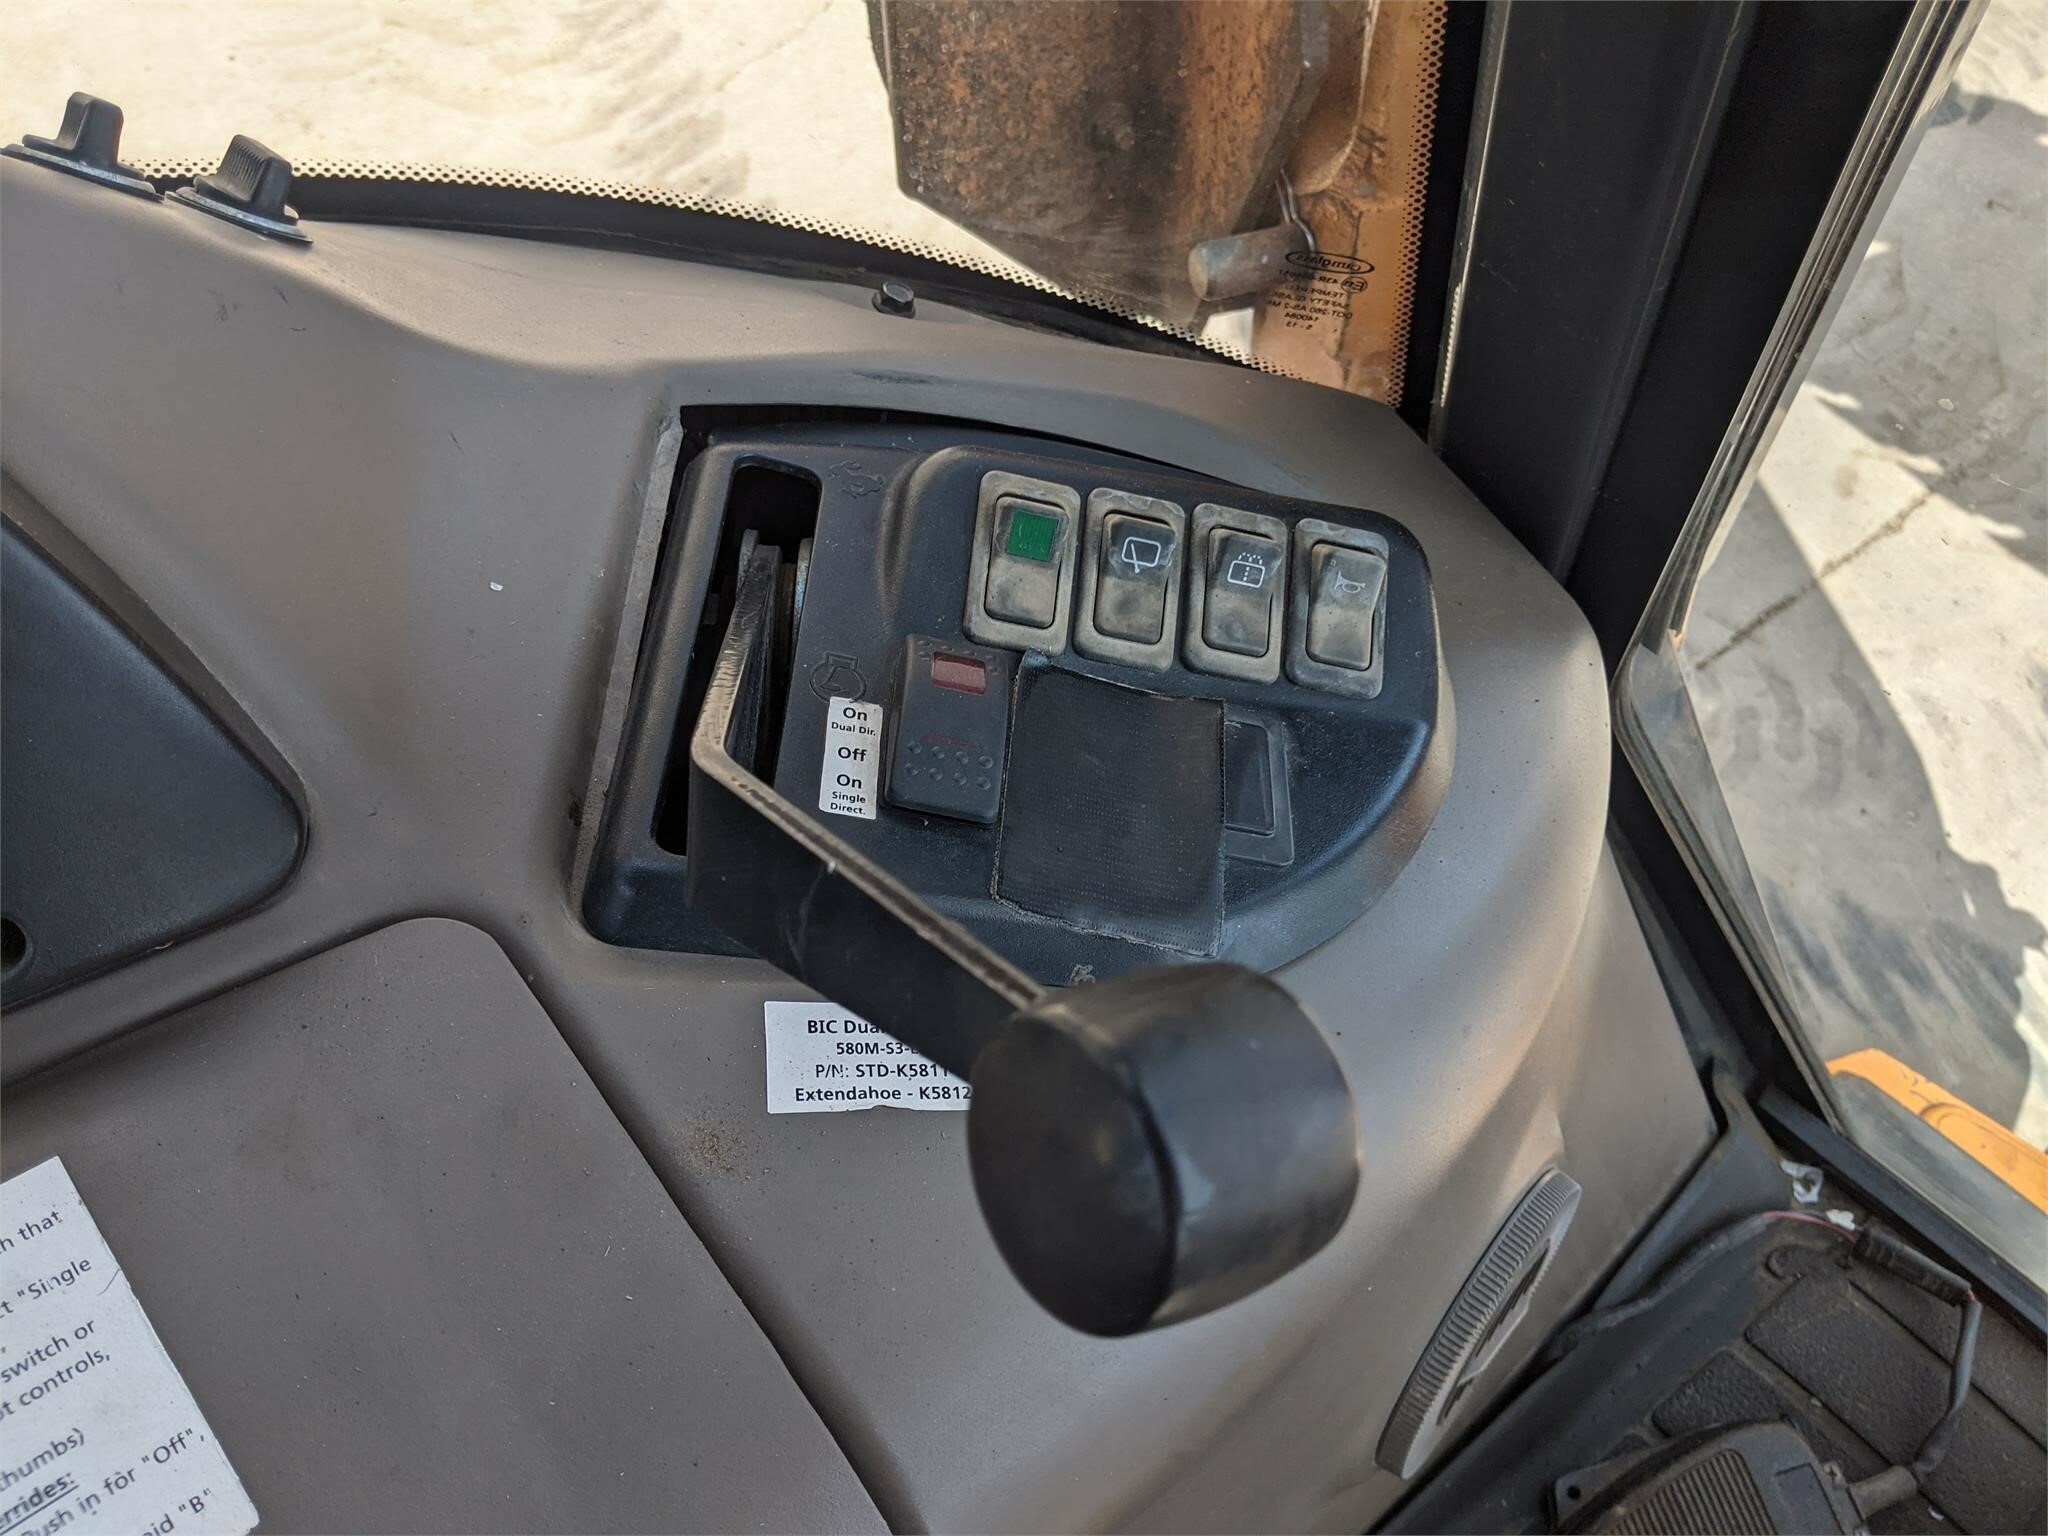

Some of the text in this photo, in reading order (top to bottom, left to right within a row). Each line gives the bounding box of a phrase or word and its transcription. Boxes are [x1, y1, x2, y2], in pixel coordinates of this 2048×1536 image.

[843, 707, 868, 721] On
[831, 721, 876, 736] Dual Dir.
[837, 746, 867, 762] Off
[836, 774, 862, 789] On
[831, 791, 866, 803] Single
[830, 802, 866, 815] Direct.
[807, 1020, 837, 1034] BIC
[815, 1064, 849, 1078] P/N:
[795, 1086, 902, 1102] Extendahoe
[919, 1086, 971, 1100] K5812
[17, 1211, 60, 1240] that
[17, 1259, 91, 1299] "Single
[1, 1320, 95, 1382] switch or
[19, 1350, 110, 1406] controls,
[76, 1493, 101, 1513] in
[104, 1468, 135, 1495] for
[178, 1488, 211, 1514] "B"
